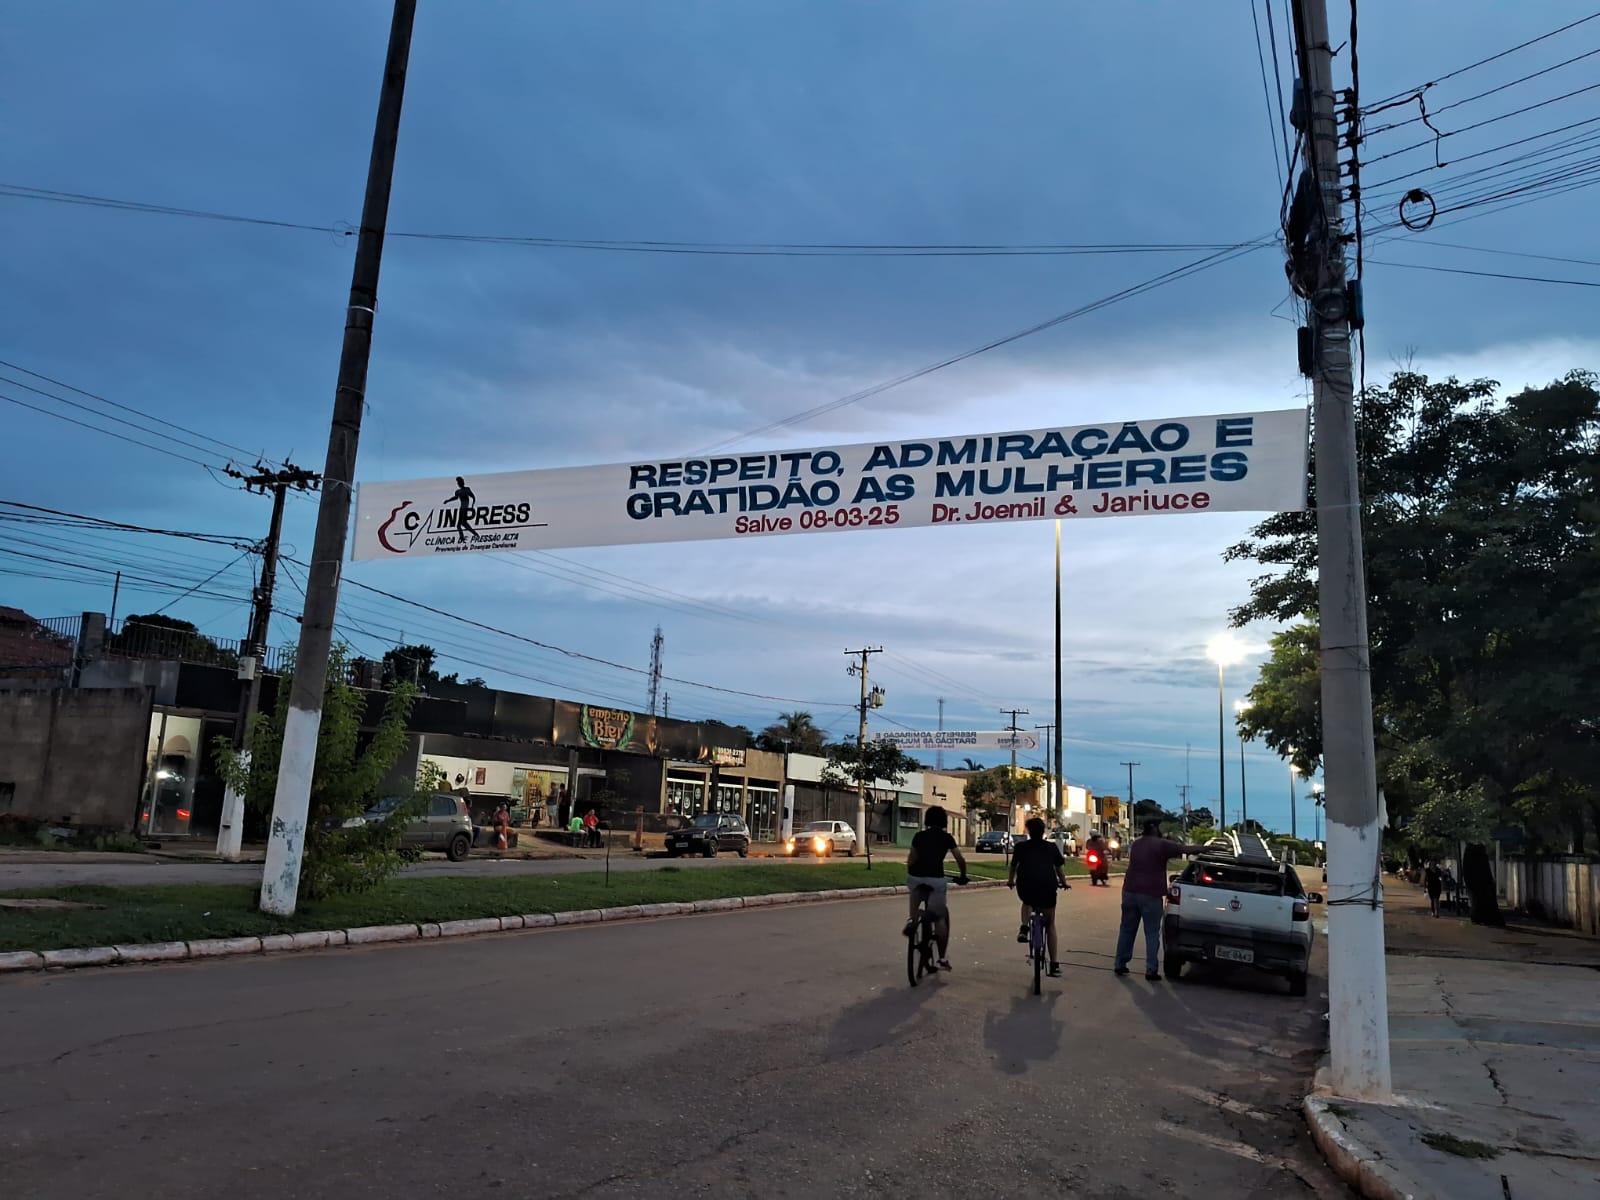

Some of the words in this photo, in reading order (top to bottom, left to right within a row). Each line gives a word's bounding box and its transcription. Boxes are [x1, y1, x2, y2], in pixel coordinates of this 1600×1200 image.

[629, 450, 844, 489] RESPEITO,
[862, 422, 1190, 472] ADMIRAÇÃO
[1215, 416, 1253, 448] E
[626, 477, 840, 520] GRATIDÃO
[851, 473, 915, 504] AS
[934, 451, 1248, 498] MULHERES
[735, 514, 792, 534] Salve
[799, 505, 900, 529] 08-03-25
[1054, 494, 1078, 516] &
[1092, 490, 1210, 513] Jariuce
[502, 533, 519, 541] ALTA
